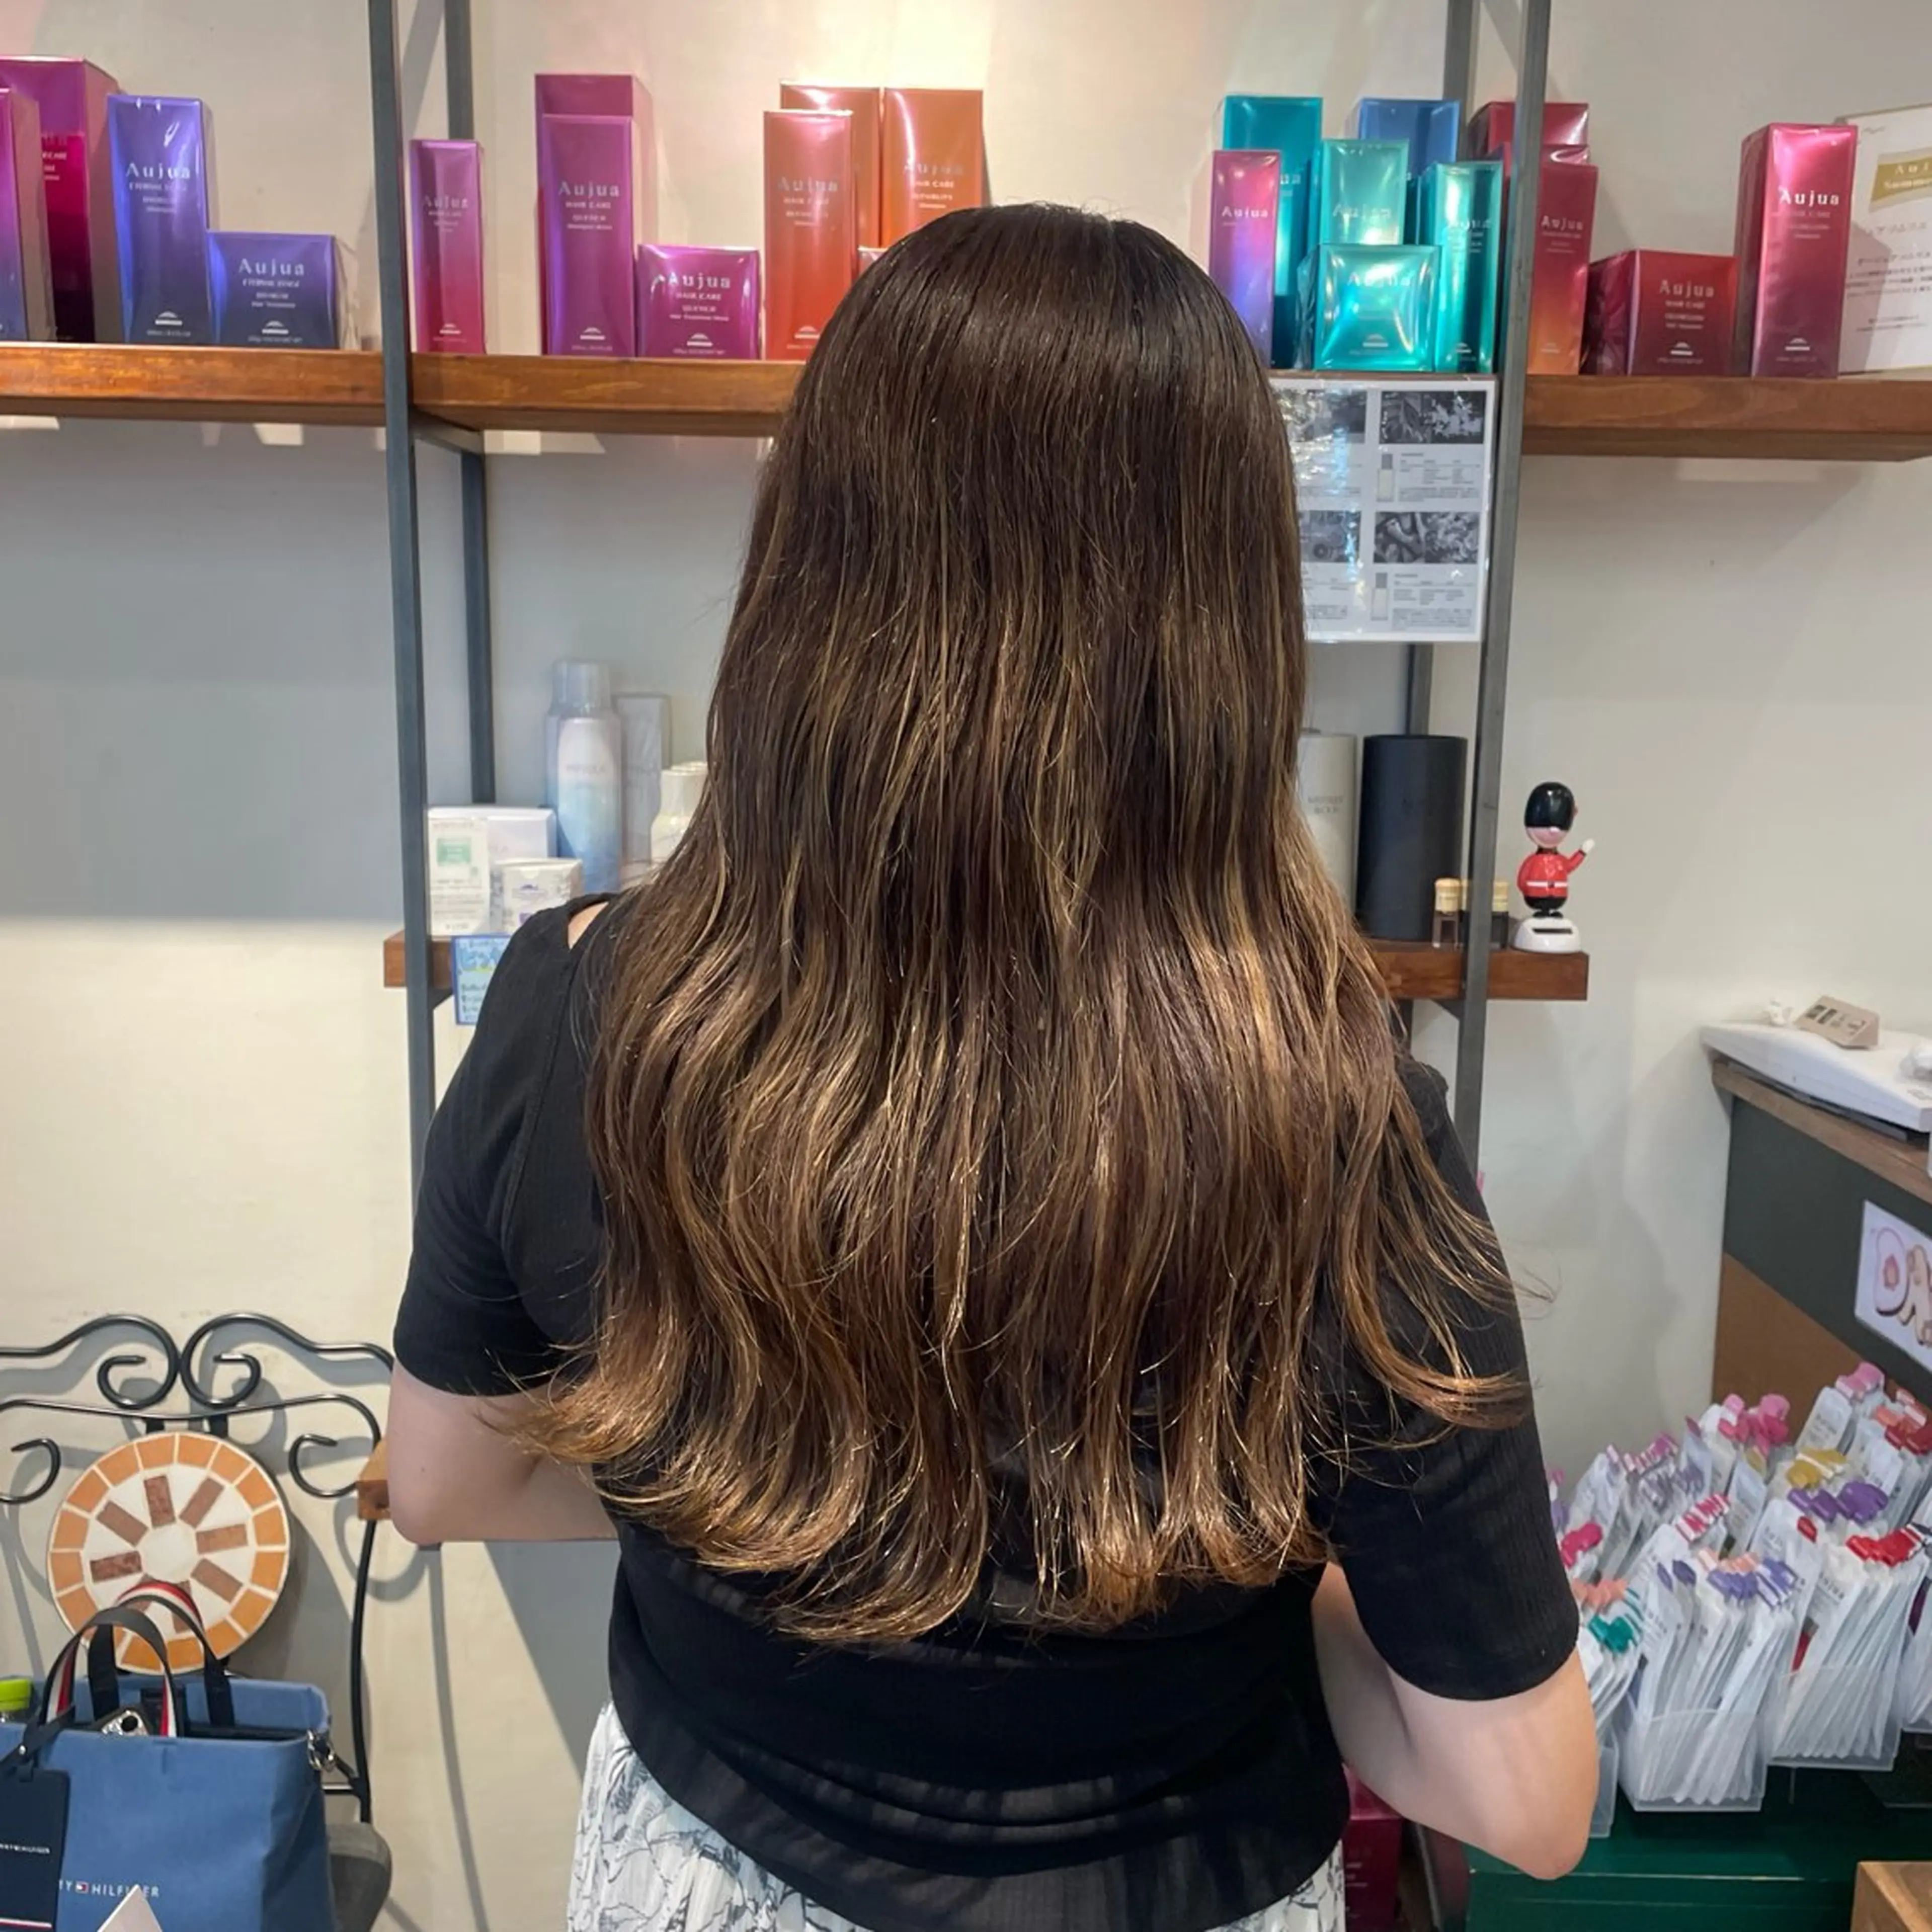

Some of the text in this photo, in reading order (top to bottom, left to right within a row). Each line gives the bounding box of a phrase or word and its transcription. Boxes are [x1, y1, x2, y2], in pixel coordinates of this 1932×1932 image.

[125, 162, 190, 180] Aujua
[558, 181, 619, 199] Aujua
[1779, 190, 1839, 207] Aujua
[1222, 206, 1268, 218] Aujua
[1541, 215, 1583, 231] Aujua
[239, 258, 304, 277] Aujua
[669, 272, 731, 290] Aujua
[1660, 280, 1714, 298] Aujua
[92, 1884, 159, 1898] HILFIER
